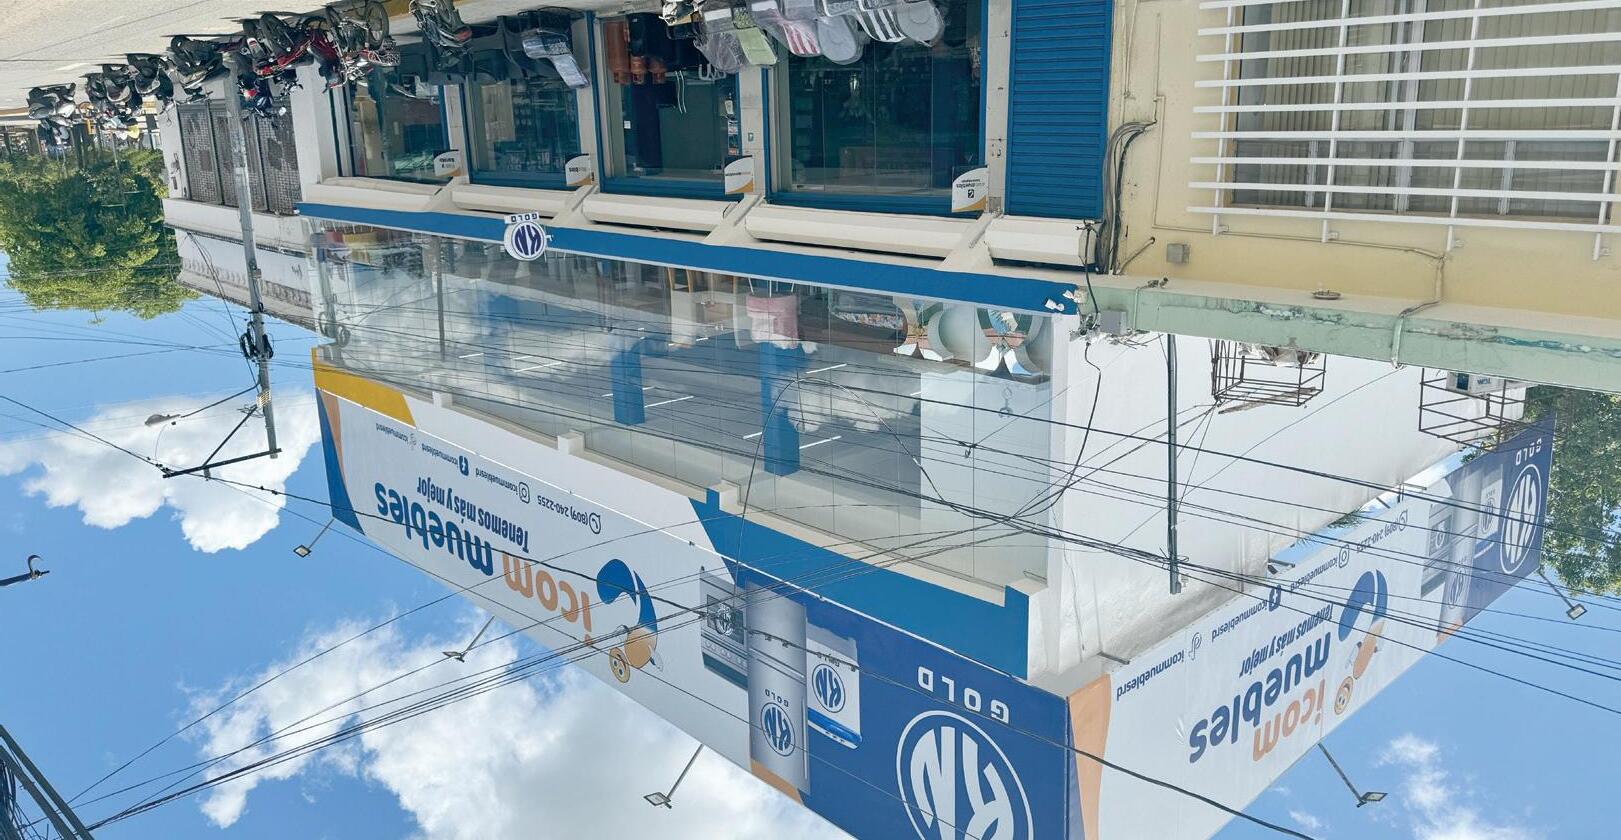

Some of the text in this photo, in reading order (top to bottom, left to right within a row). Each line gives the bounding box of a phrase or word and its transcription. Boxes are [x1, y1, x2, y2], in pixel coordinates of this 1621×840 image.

[511, 213, 538, 223] GOLD
[514, 224, 541, 256] KN
[1515, 438, 1542, 466] GOLD
[475, 468, 518, 495] icommueblesrd
[416, 477, 529, 553] Tenemos más y mejor
[537, 495, 588, 526] (809) 240-2255
[374, 482, 592, 647] icom muebles
[1268, 636, 1276, 659] y
[1275, 627, 1296, 656] más
[1116, 649, 1185, 701] icommueblesrd
[1238, 644, 1269, 678] mejor
[764, 689, 789, 707] GOLD
[815, 668, 841, 708] KN
[917, 666, 1009, 724] GOLD
[1189, 632, 1331, 764] muebles
[763, 706, 791, 751] KN
[1252, 679, 1325, 762] icom
[910, 725, 1014, 840] KN
